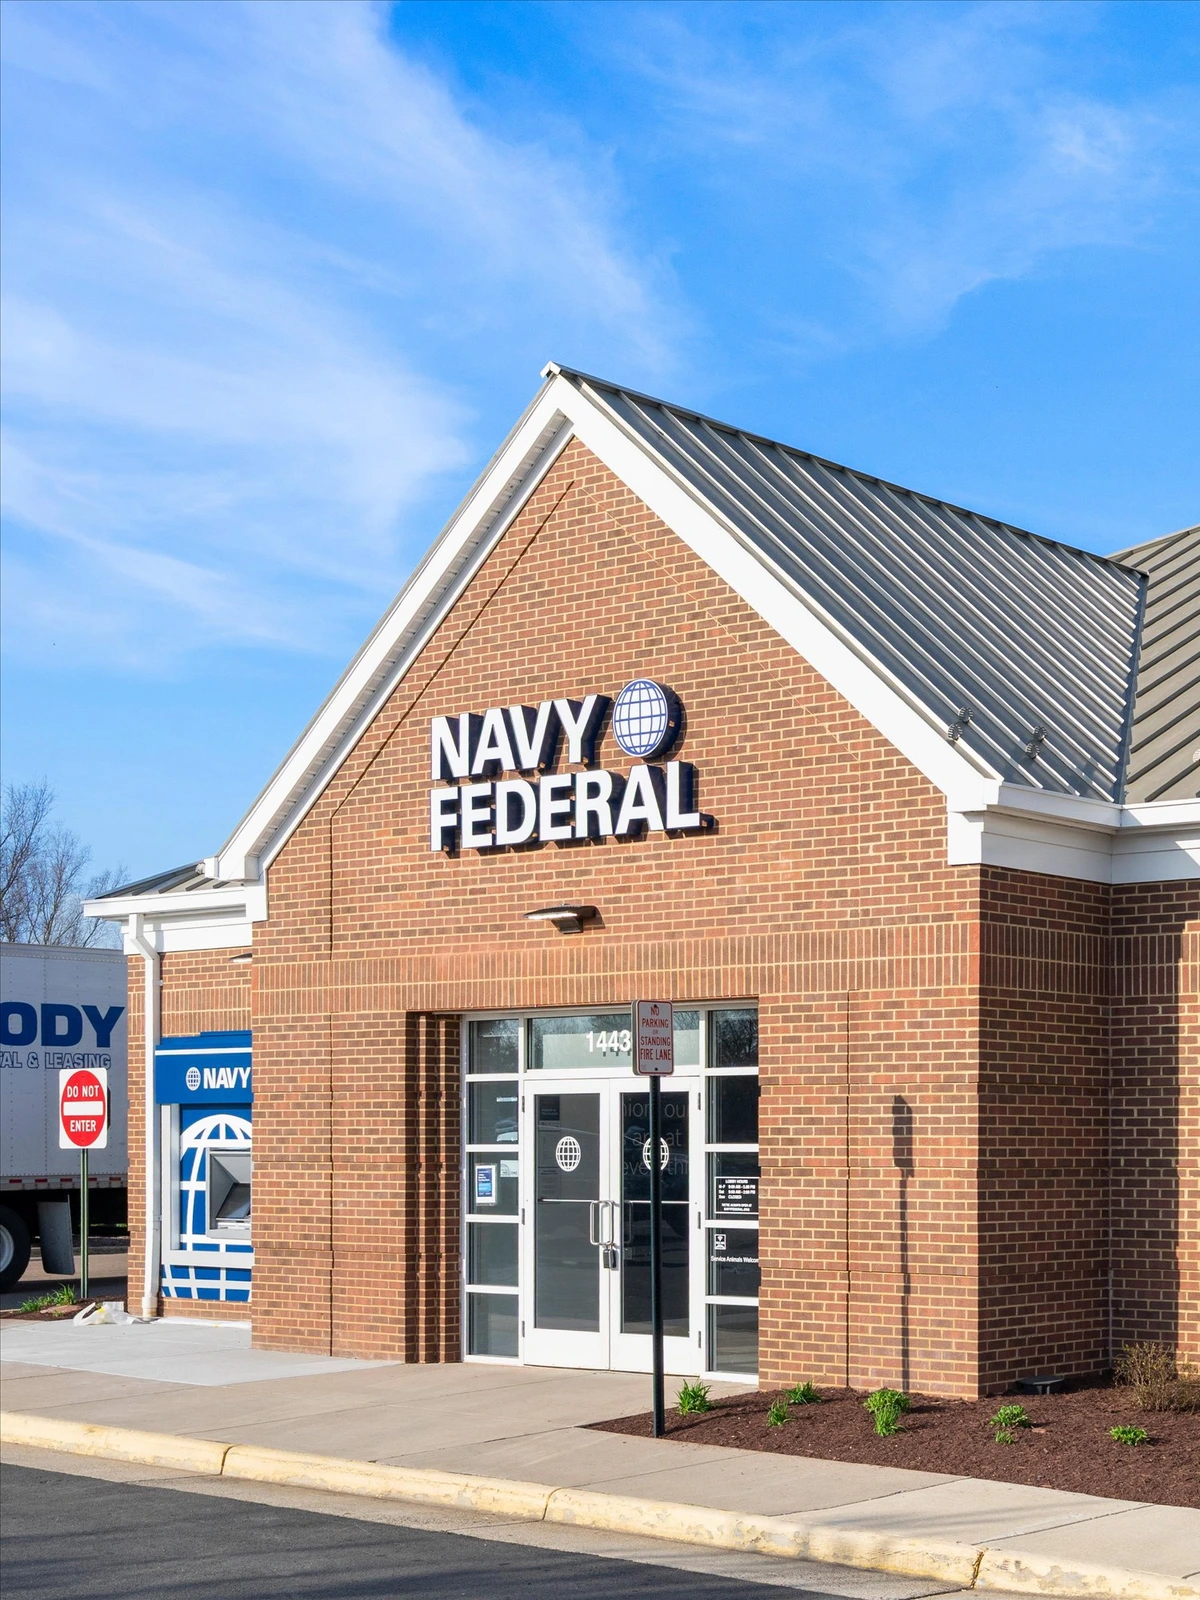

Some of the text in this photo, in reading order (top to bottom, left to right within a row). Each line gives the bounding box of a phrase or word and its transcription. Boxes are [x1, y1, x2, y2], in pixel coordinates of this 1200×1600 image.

[431, 693, 600, 781] NAVY
[430, 760, 702, 852] FEDERAL
[650, 1006, 659, 1016] NO
[0, 1001, 126, 1048] ODY
[641, 1018, 669, 1028] PARKING
[586, 1029, 631, 1053] 1443
[640, 1036, 671, 1046] STANDING
[27, 1051, 39, 1070] &
[44, 1051, 111, 1070] LEASING
[640, 1049, 672, 1061] FIRE LANE
[203, 1066, 251, 1090] NAVY
[66, 1084, 100, 1098] DO NOT
[70, 1119, 97, 1132] ENTER
